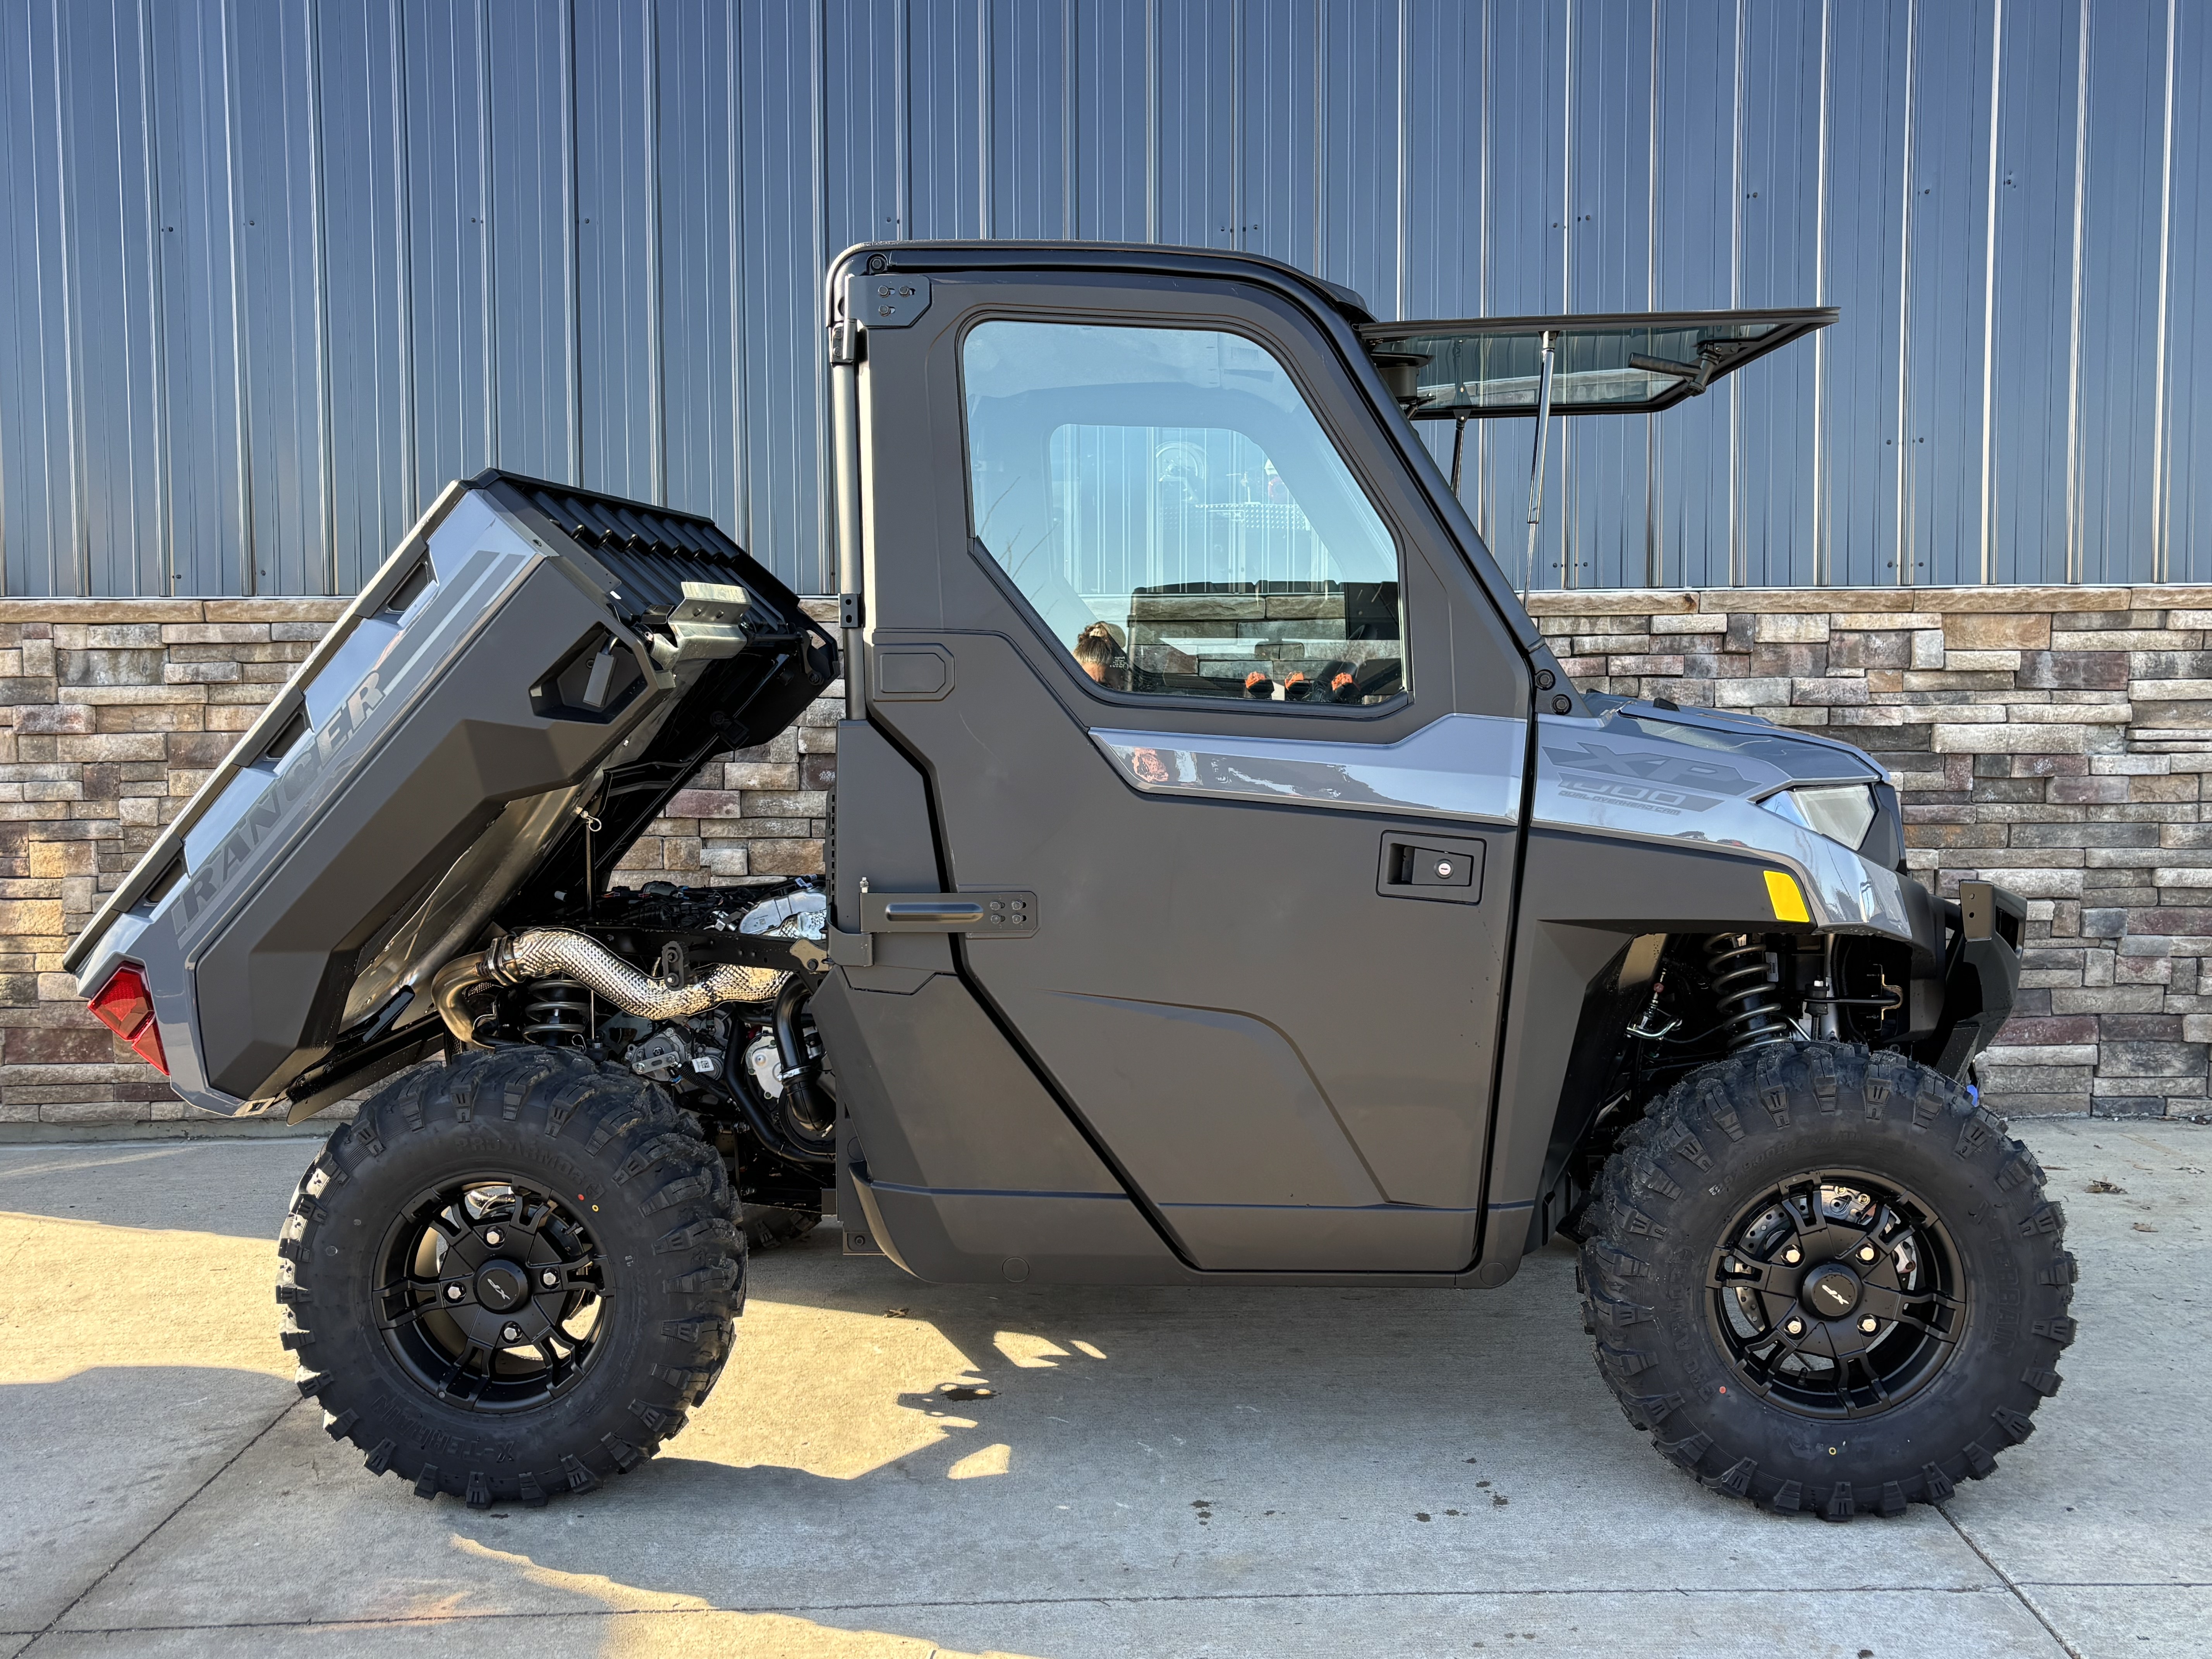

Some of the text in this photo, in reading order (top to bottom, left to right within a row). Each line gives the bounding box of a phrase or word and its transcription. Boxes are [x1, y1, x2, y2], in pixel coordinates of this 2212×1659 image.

[1553, 742, 1747, 784] XP
[179, 670, 386, 926] RANGER
[1560, 778, 1686, 805] 1000
[507, 1140, 586, 1185] ARMOR
[487, 1278, 511, 1300] XP
[1822, 1284, 1850, 1305] XP
[370, 1394, 515, 1463] X-TERRAIN
